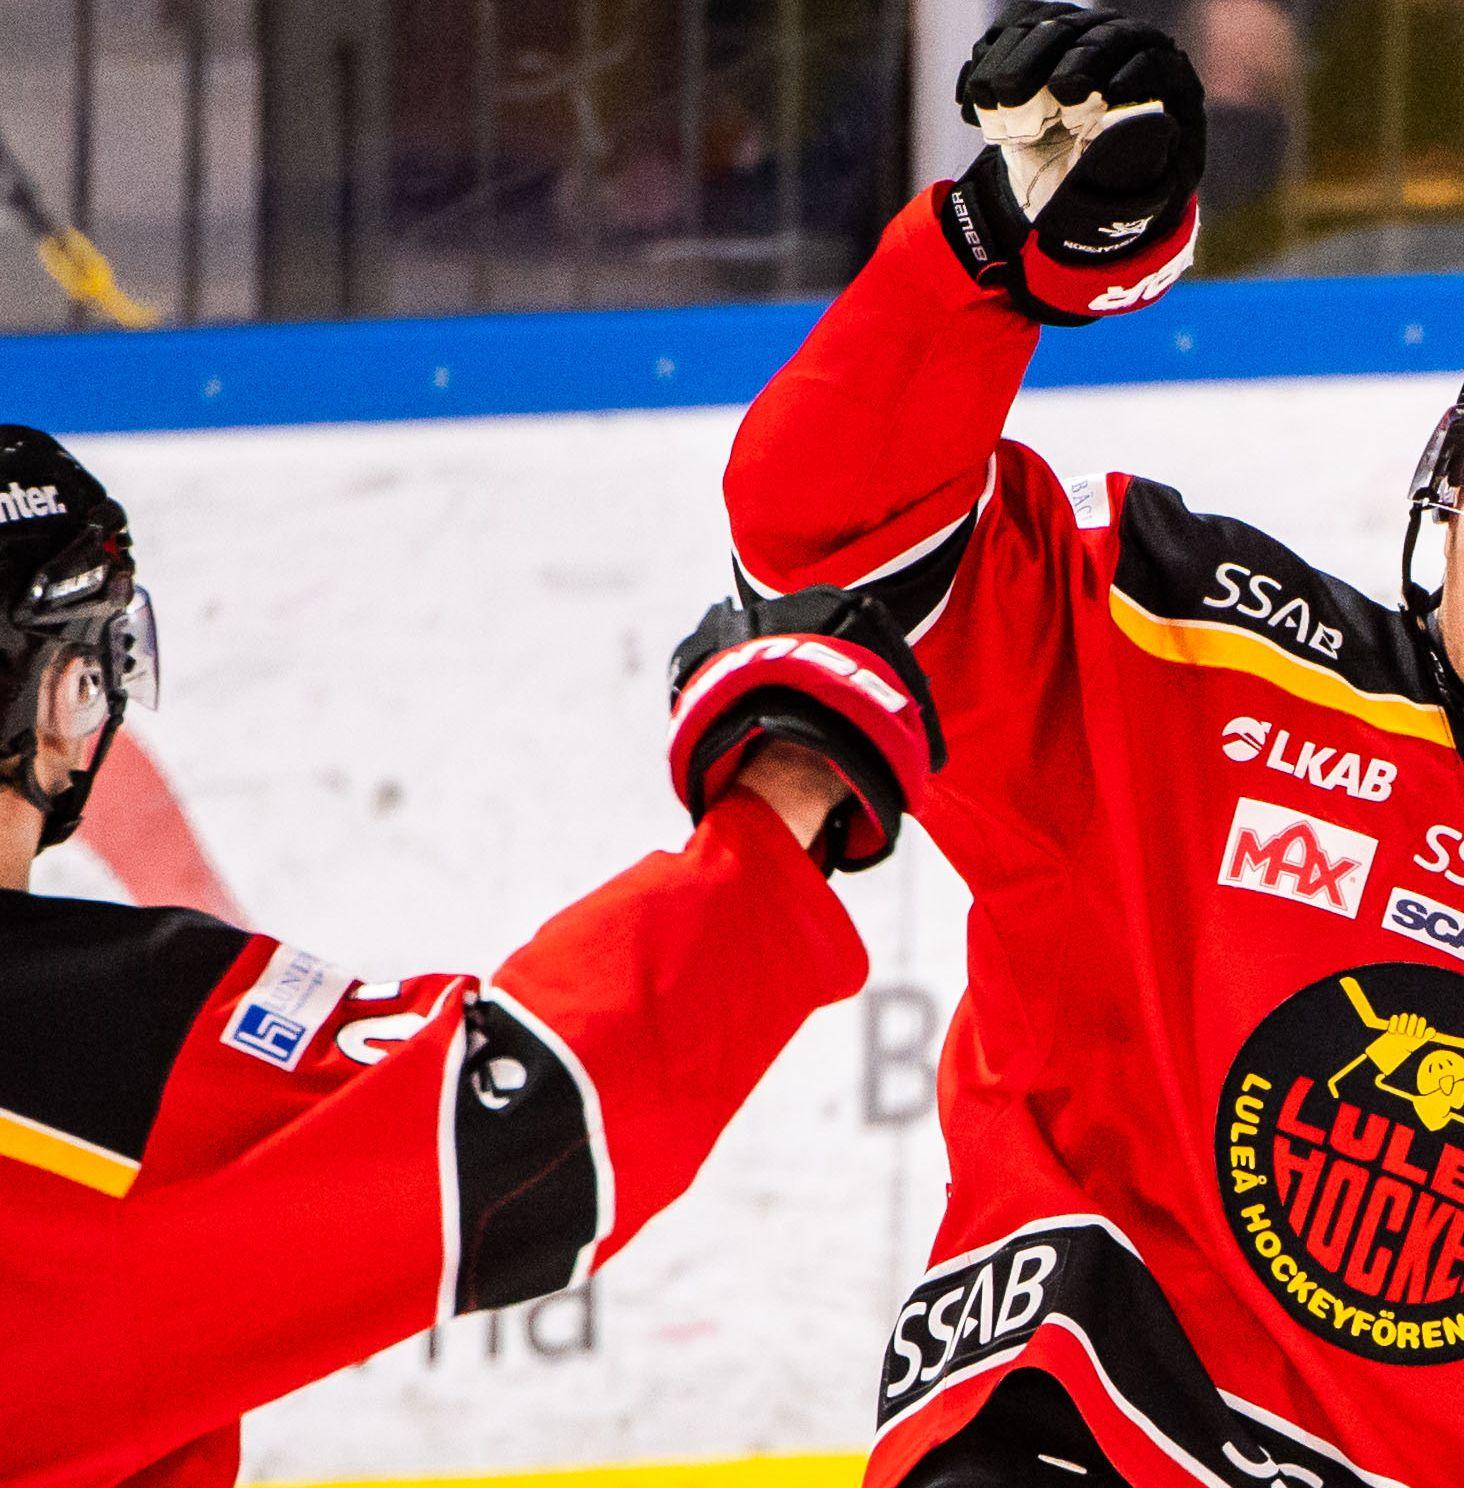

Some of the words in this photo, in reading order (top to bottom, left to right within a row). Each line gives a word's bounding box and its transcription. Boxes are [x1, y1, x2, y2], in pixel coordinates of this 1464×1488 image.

[1202, 562, 1344, 660] SSAB
[1266, 729, 1398, 802] LKAB
[1225, 820, 1362, 912] MAX
[1230, 1072, 1272, 1195] LULEÅ
[886, 1244, 1058, 1399] SSAB
